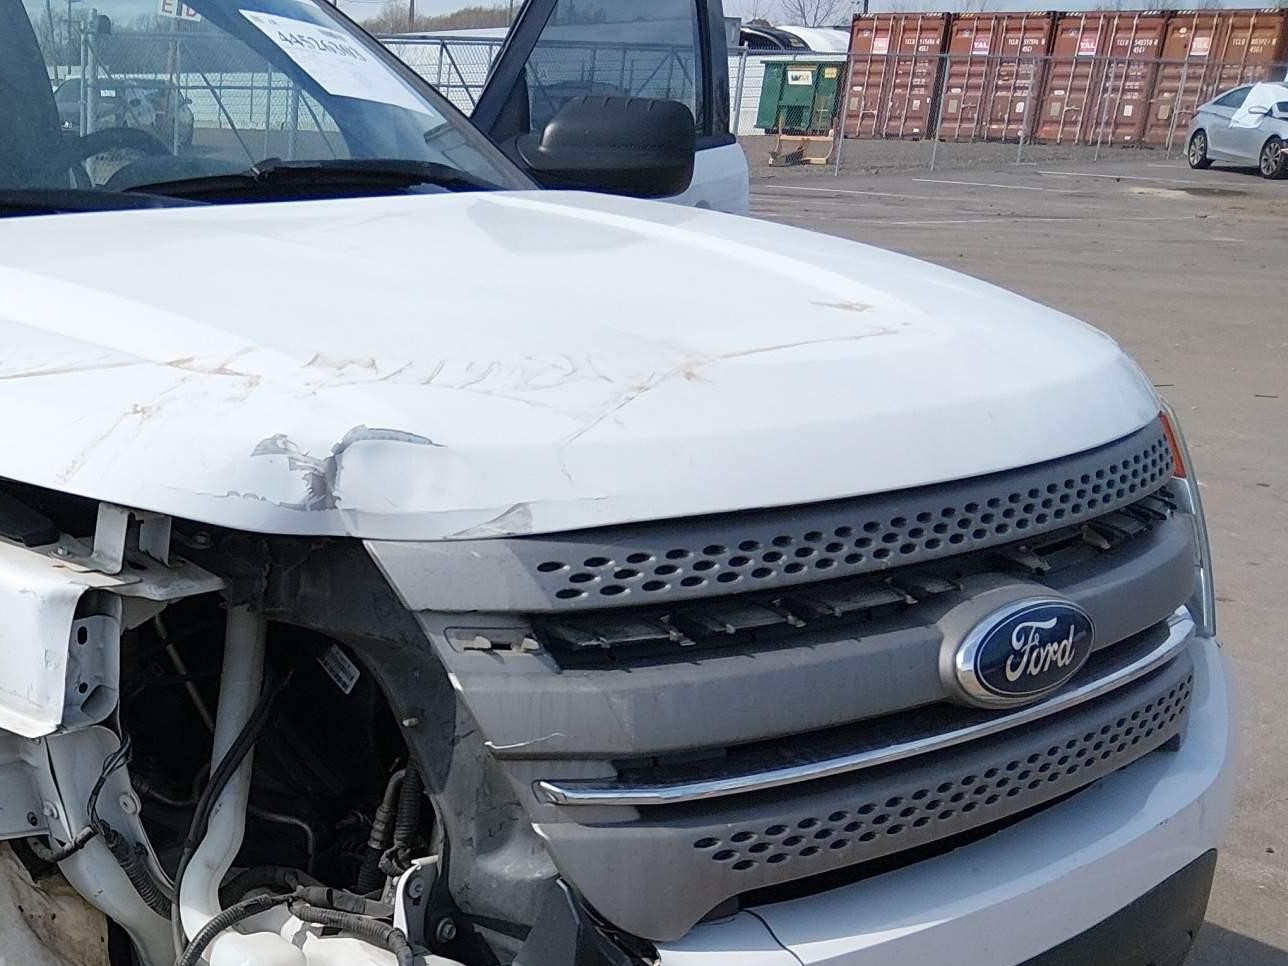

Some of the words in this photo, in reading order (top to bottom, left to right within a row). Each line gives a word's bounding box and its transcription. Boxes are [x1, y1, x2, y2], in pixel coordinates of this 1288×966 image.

[974, 41, 989, 49] TAL
[1080, 41, 1096, 49] TAL
[1005, 617, 1076, 682] Ford
